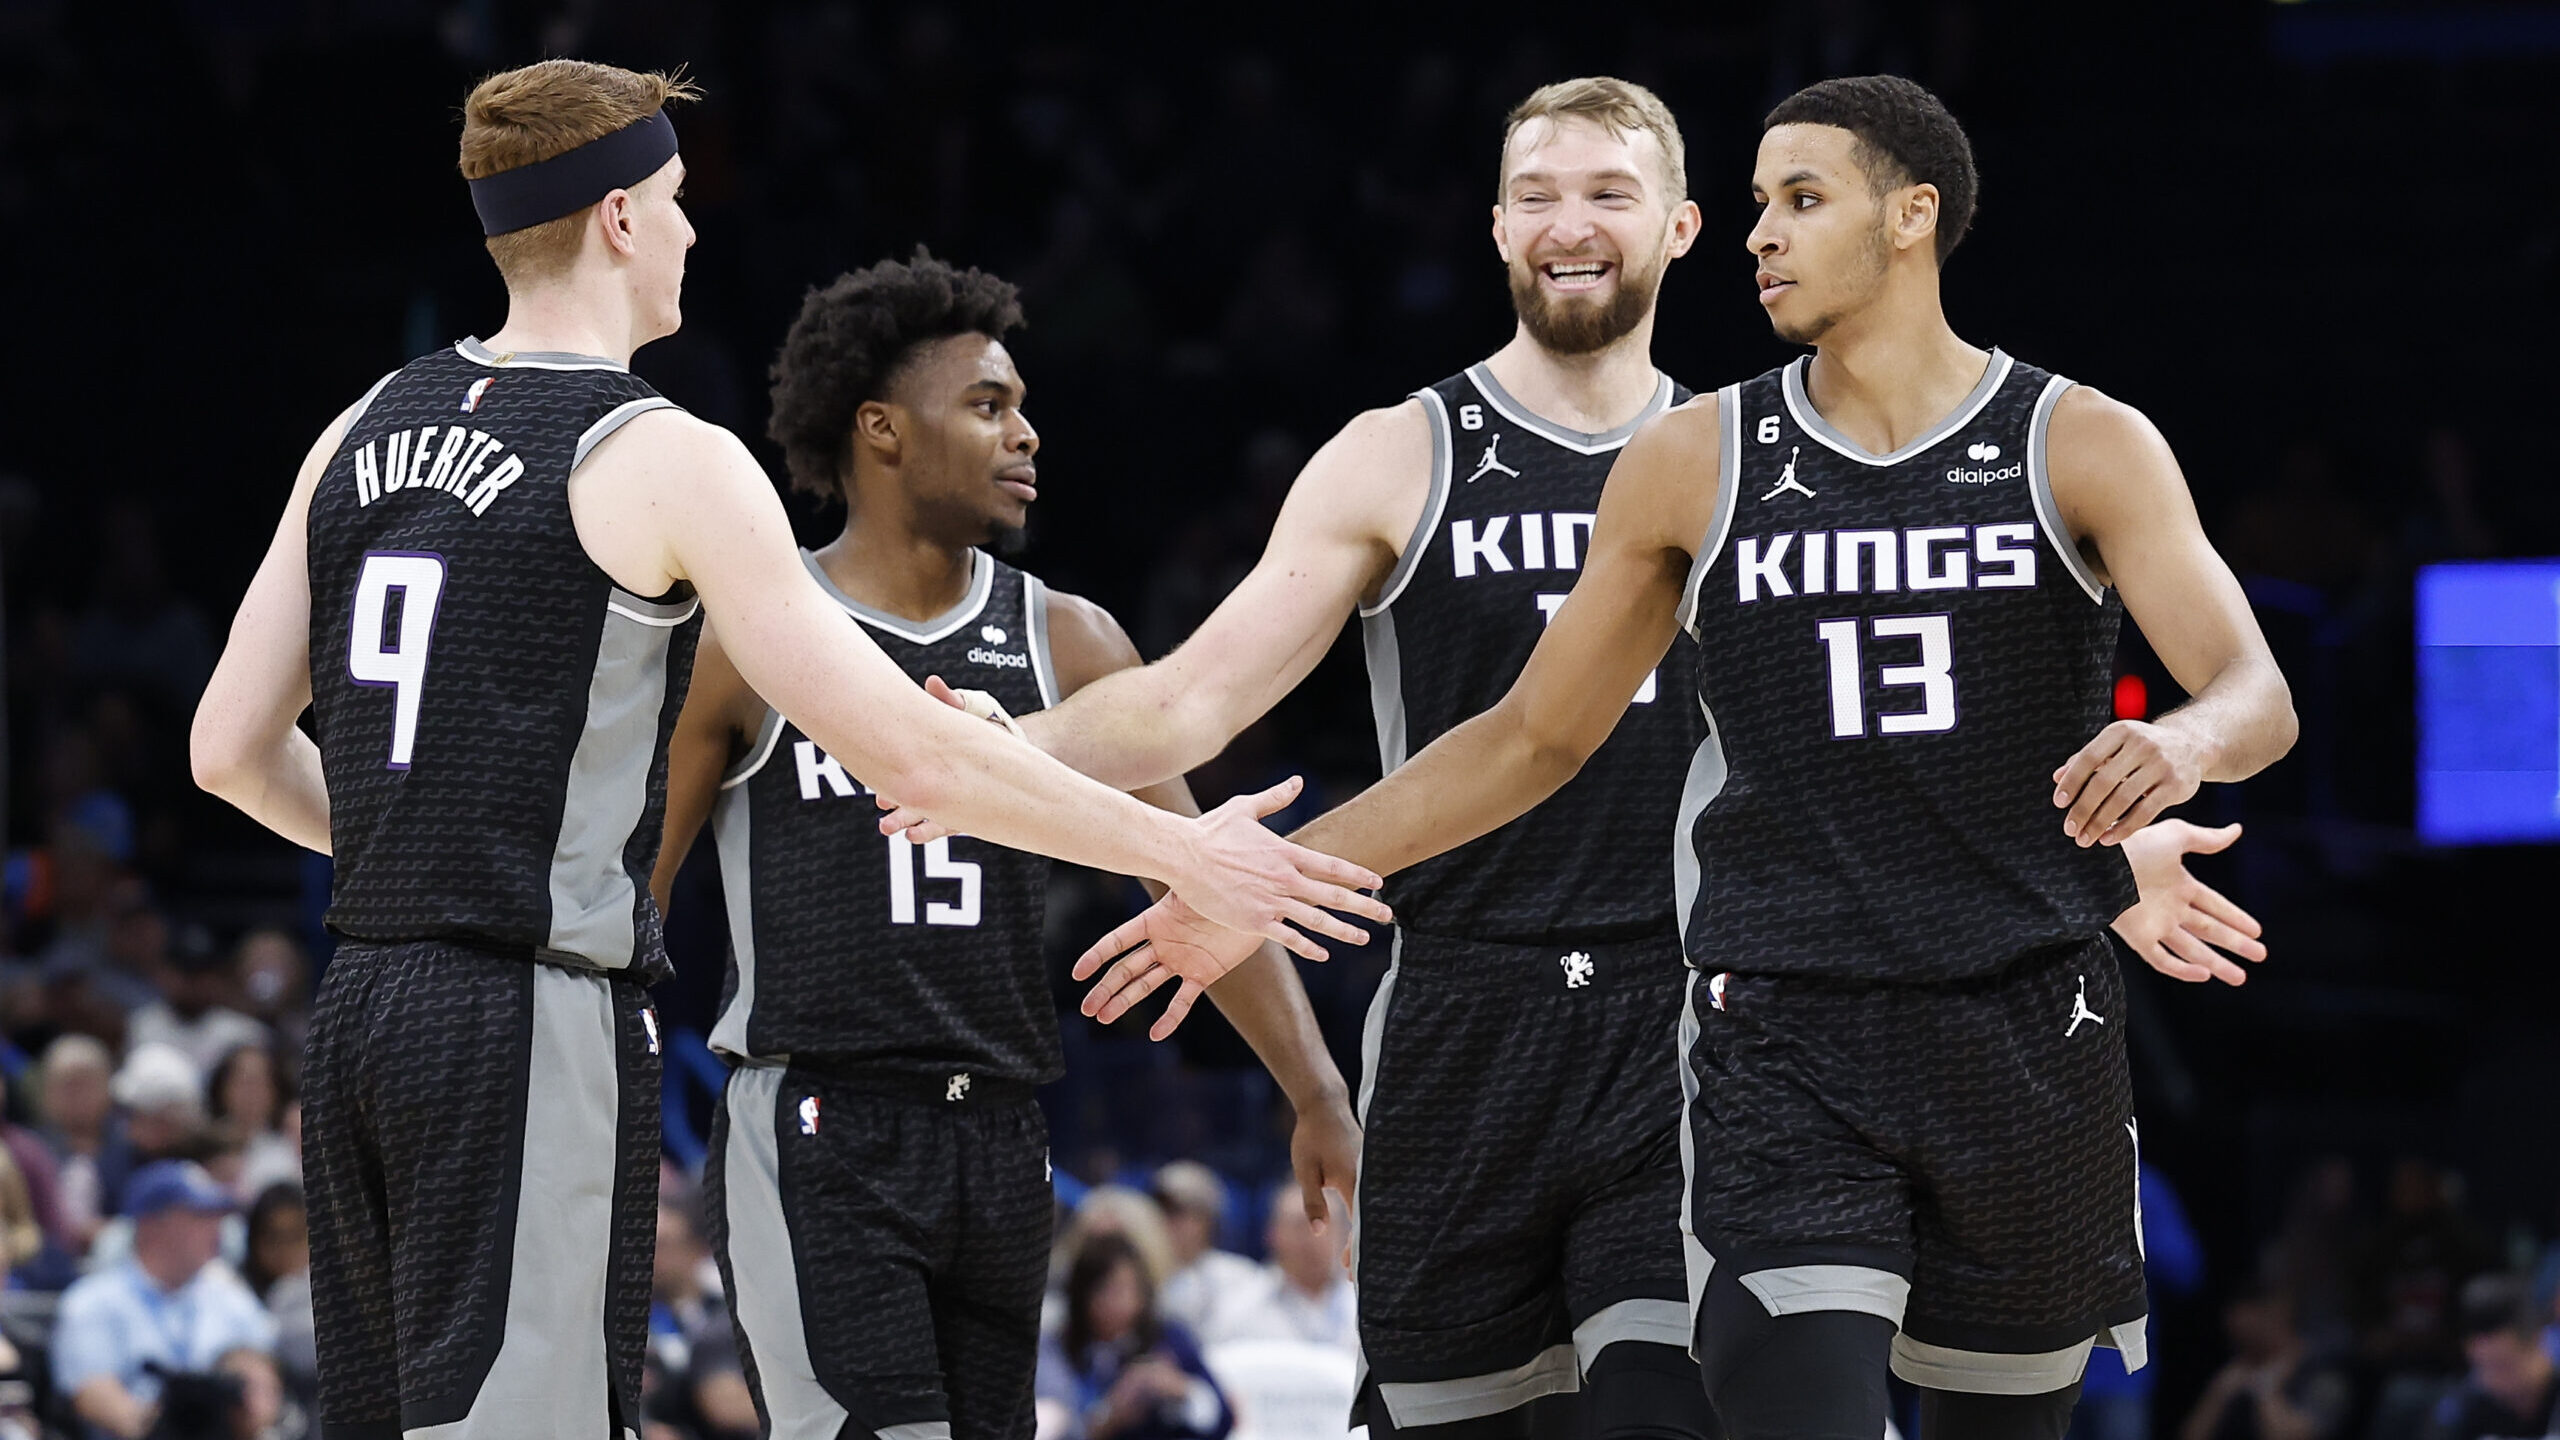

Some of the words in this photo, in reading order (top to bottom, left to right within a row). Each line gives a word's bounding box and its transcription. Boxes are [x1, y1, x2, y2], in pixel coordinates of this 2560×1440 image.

[1459, 404, 1484, 430] 6
[1756, 415, 1781, 444] 6
[354, 425, 525, 518] HUERTER
[1946, 461, 2022, 487] dialpad
[1451, 512, 1597, 578] KIN
[1736, 521, 2038, 604] KINGS
[346, 550, 448, 770] 9
[967, 647, 1028, 669] dialpad
[1815, 611, 1959, 740] 13
[880, 818, 983, 927] 15
